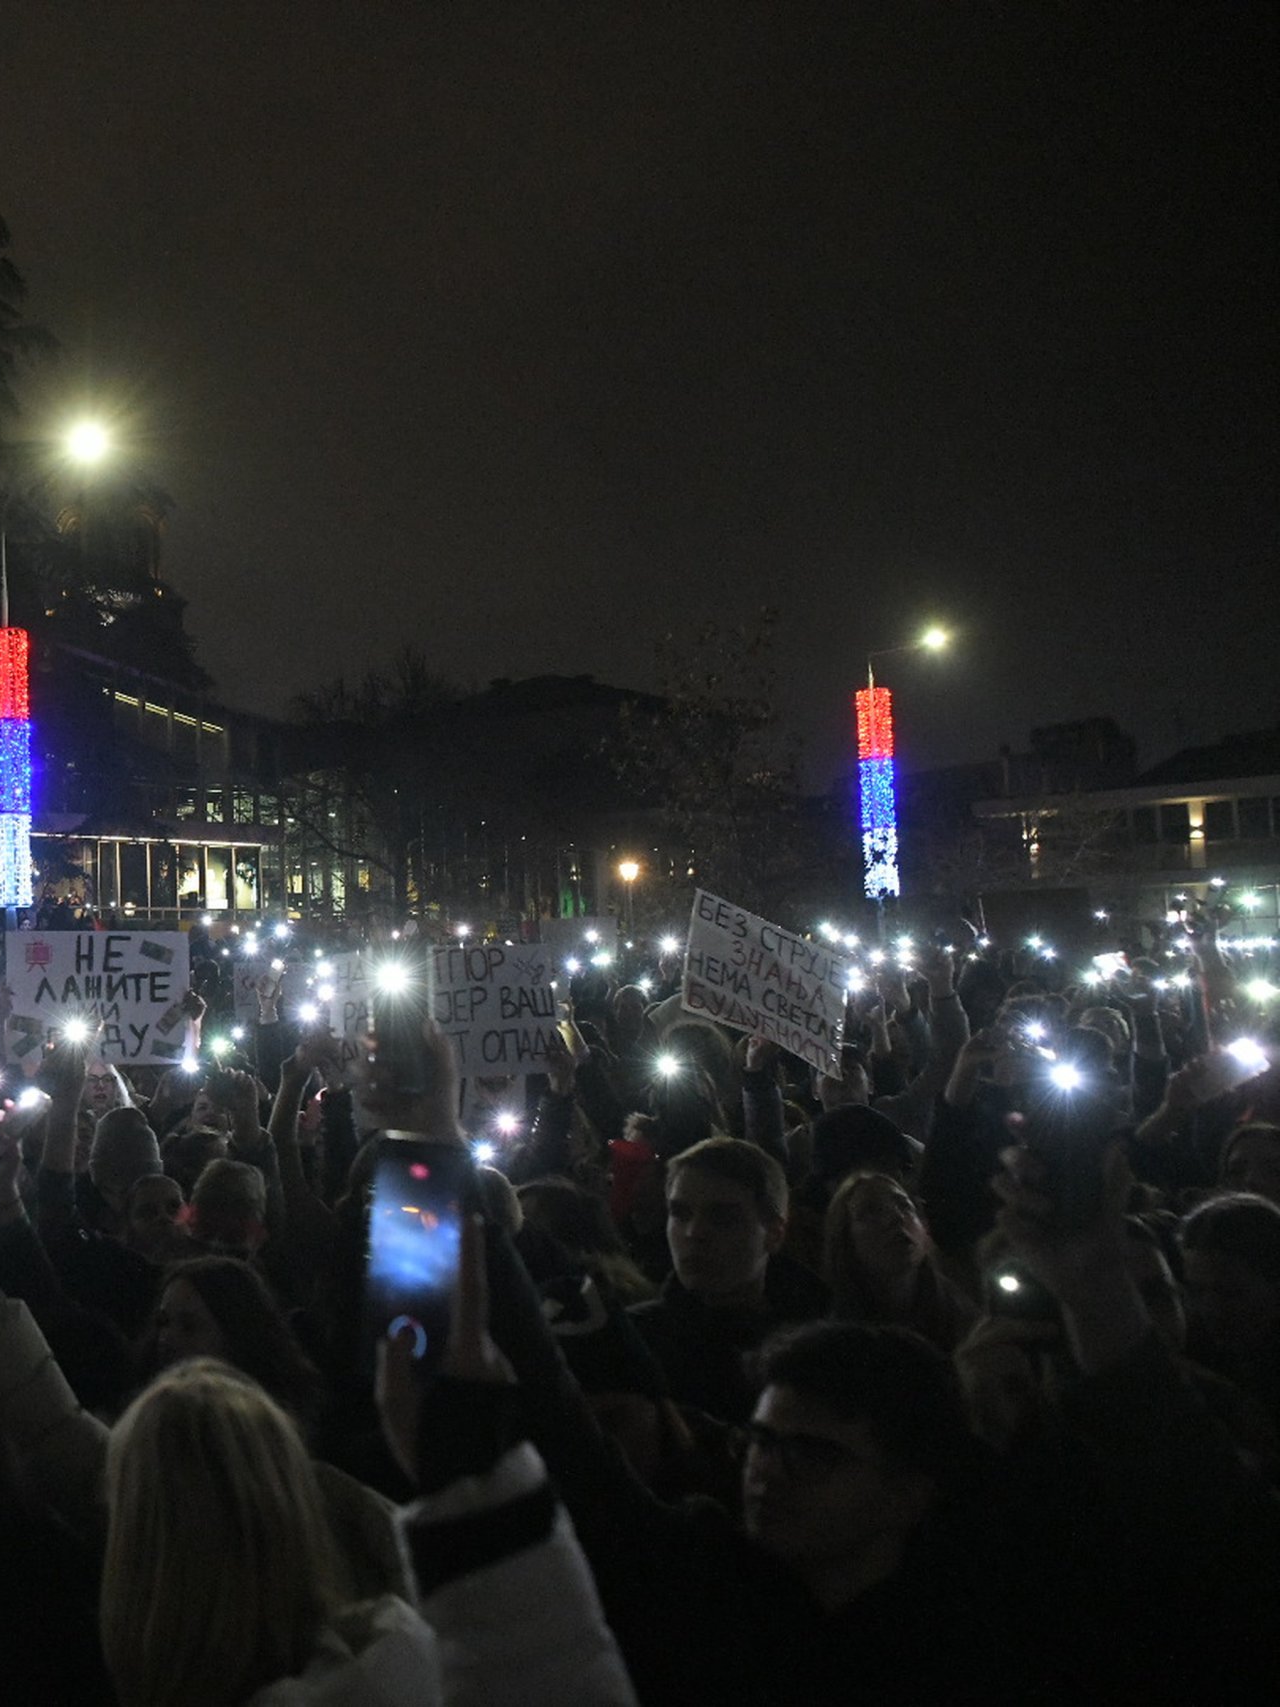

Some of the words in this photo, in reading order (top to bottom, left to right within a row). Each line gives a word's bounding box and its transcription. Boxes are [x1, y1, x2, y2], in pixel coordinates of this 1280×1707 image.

[75, 935, 132, 974] НЕ
[698, 894, 748, 938] БЕЗ
[760, 926, 843, 988] СТРУЈЕ
[432, 946, 506, 985] ТПОР
[687, 950, 753, 1001] НЕМА
[730, 940, 828, 1014] ЗНАЊА
[34, 971, 173, 1004] ЛАЖИТЕ
[435, 986, 489, 1025] ЈЕР
[499, 985, 556, 1020] ВАШ
